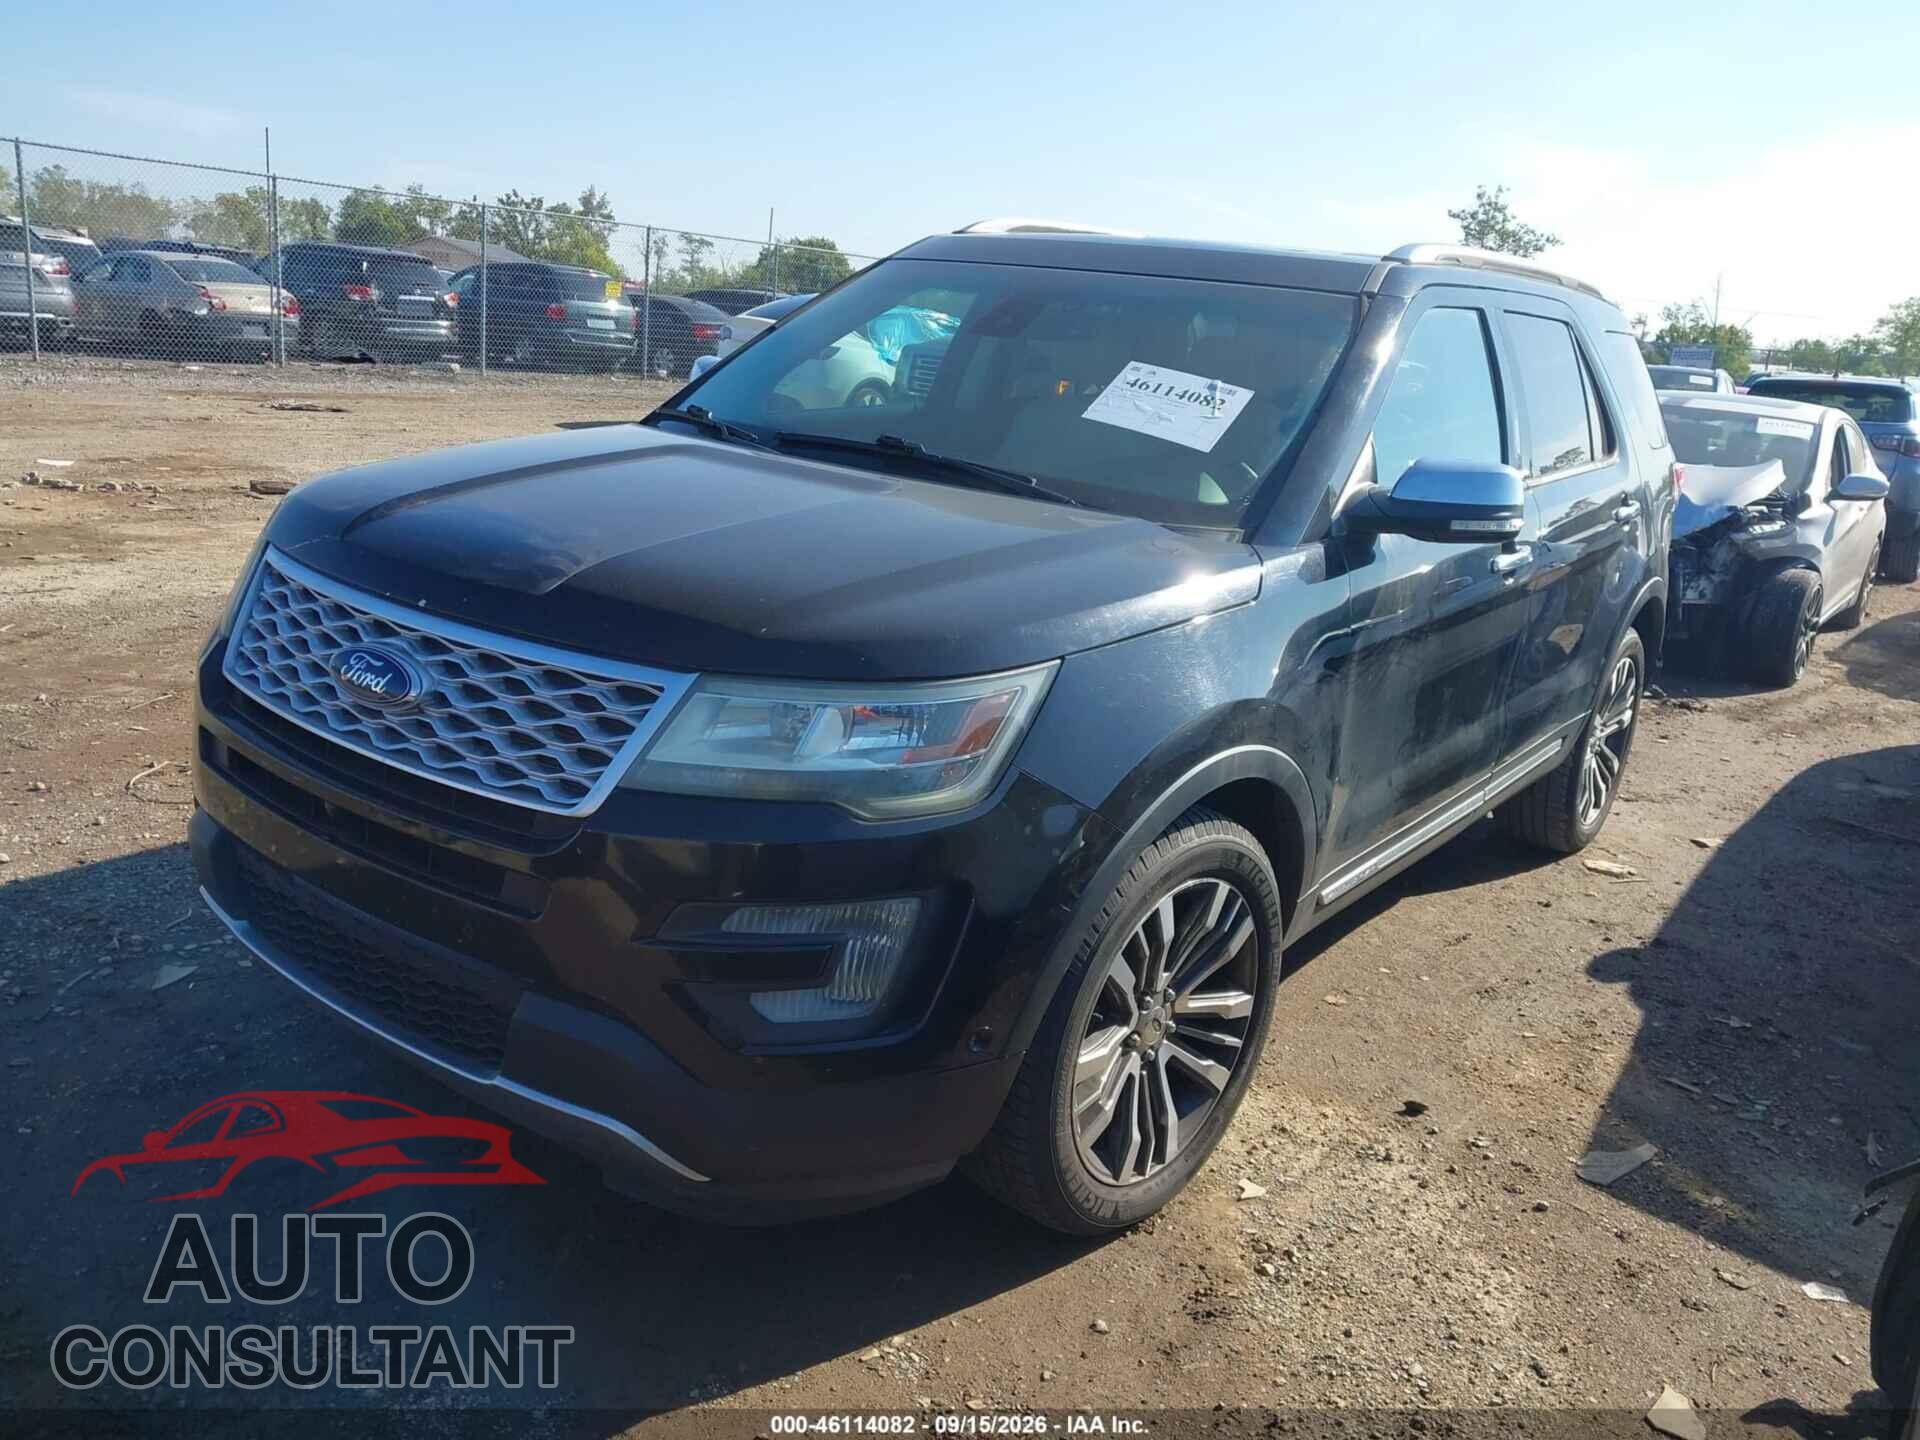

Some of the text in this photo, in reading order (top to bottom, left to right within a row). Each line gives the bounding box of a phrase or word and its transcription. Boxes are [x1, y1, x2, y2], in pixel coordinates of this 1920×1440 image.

[1126, 378, 1226, 411] 46114082
[341, 652, 393, 694] Ford
[1239, 854, 1280, 943] MICHELIN
